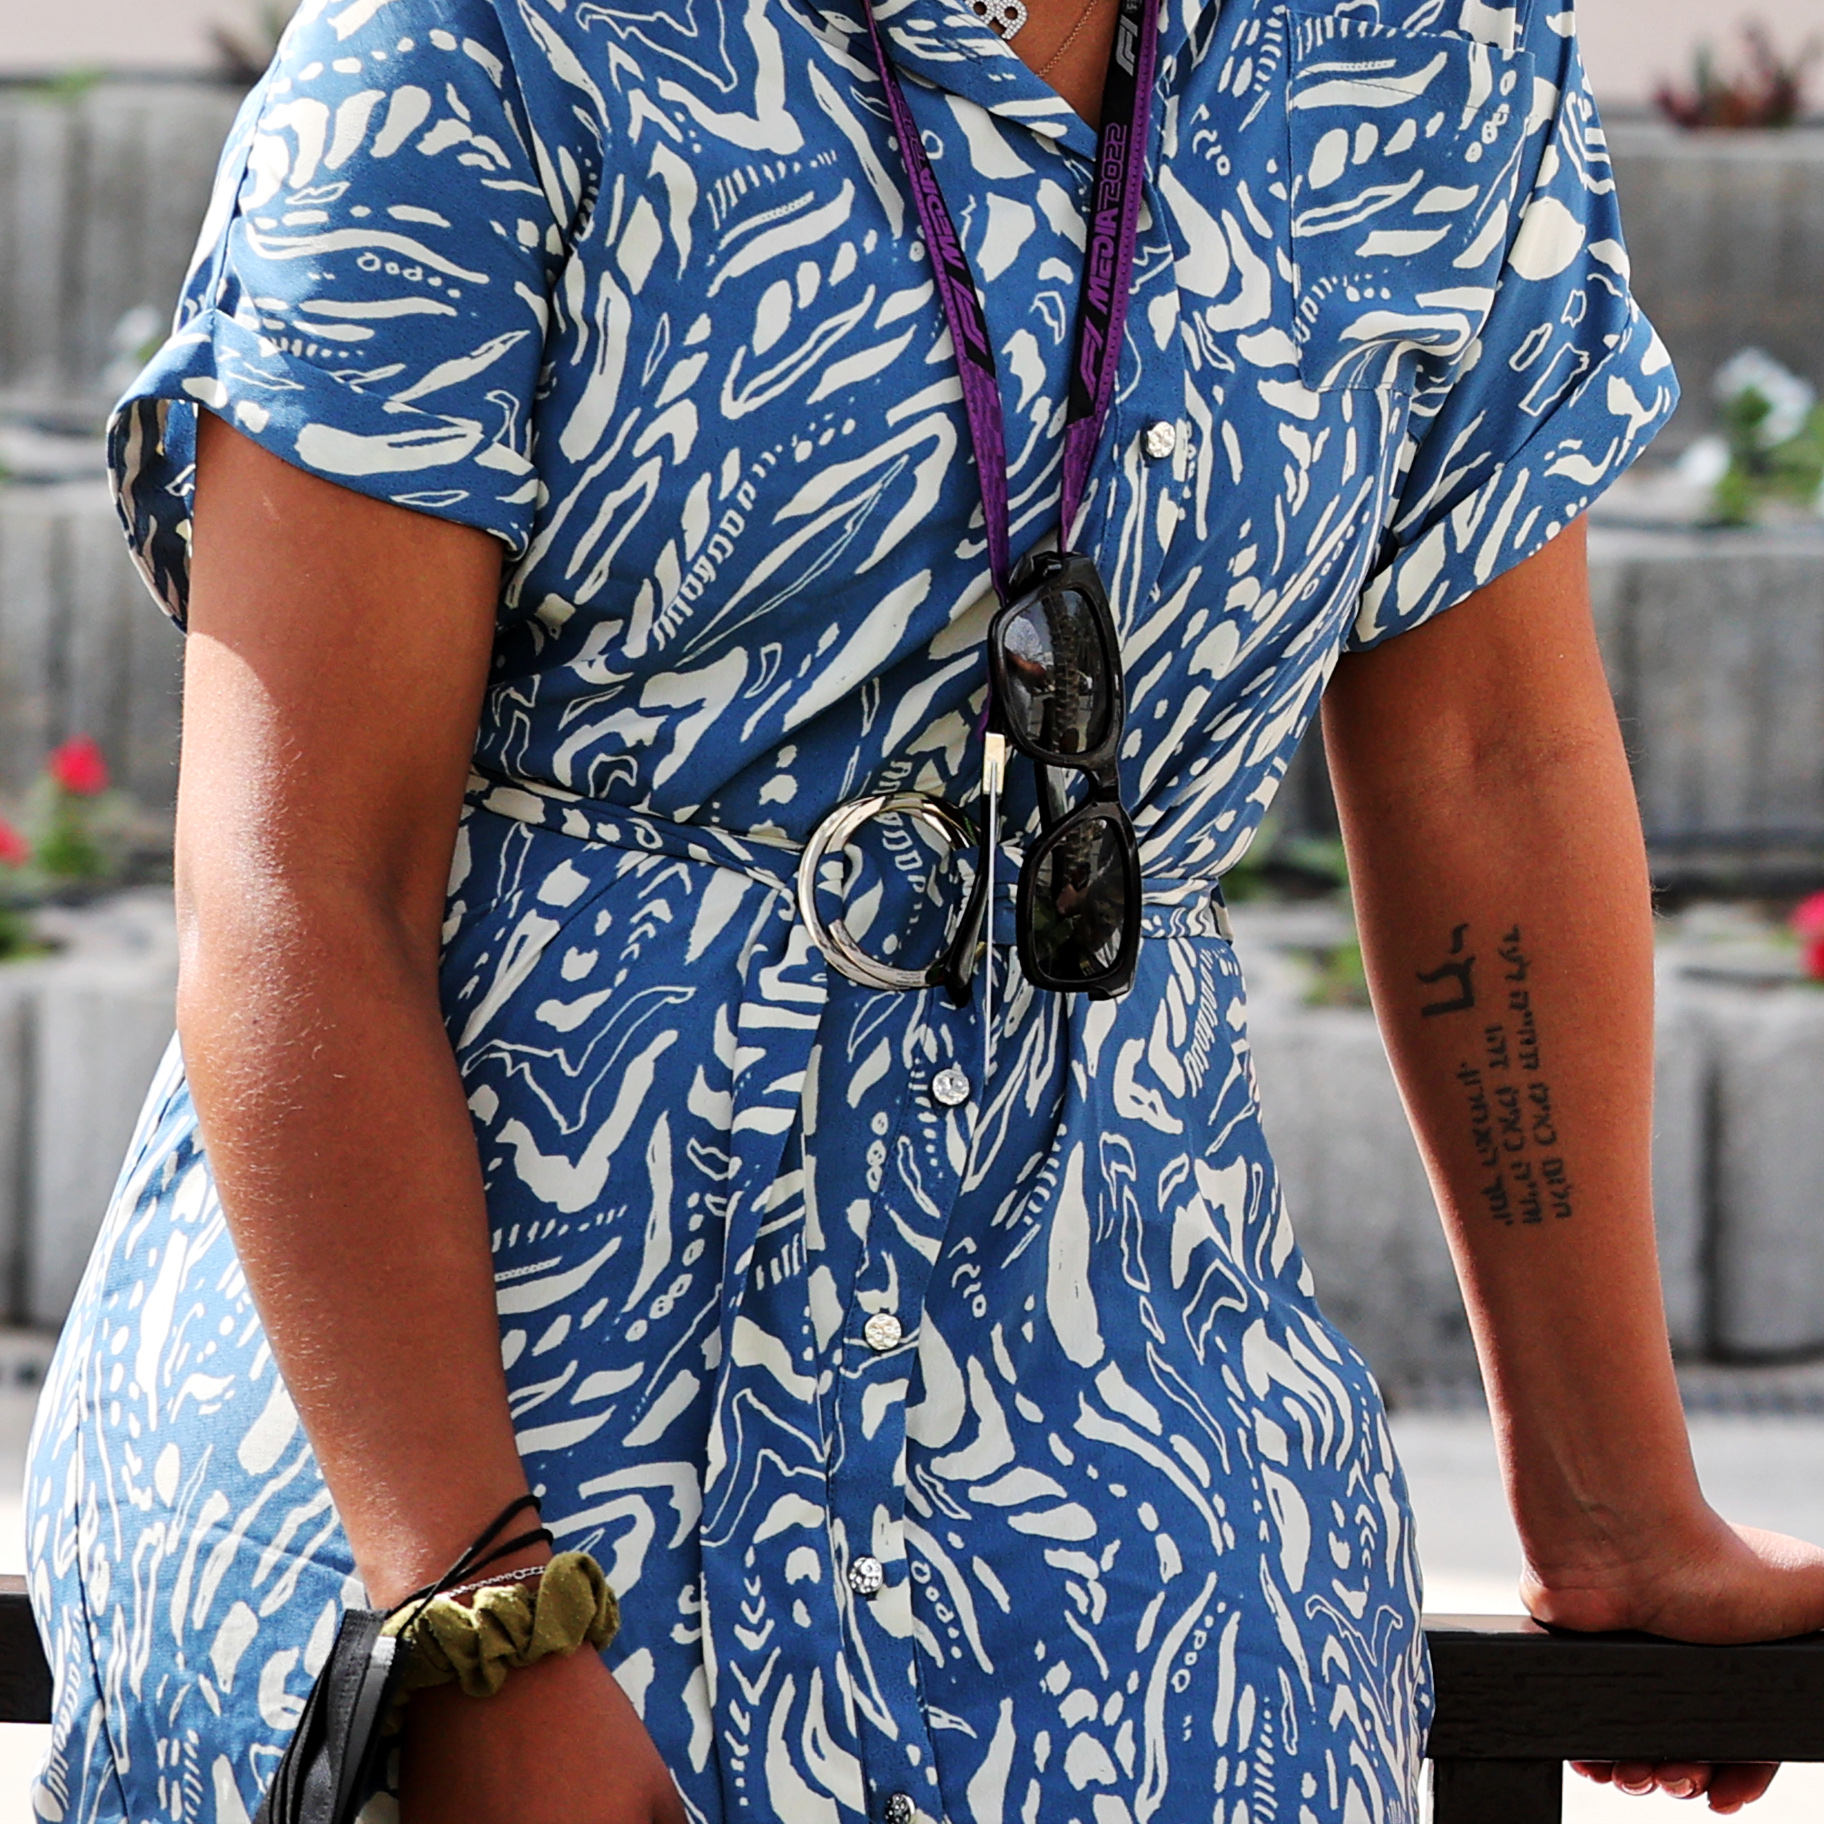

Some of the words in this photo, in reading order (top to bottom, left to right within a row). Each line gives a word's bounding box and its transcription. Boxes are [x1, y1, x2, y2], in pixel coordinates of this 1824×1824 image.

[1097, 122, 1127, 210] 2022
[920, 168, 965, 270] MEDIA
[1087, 209, 1118, 314] MEDIA
